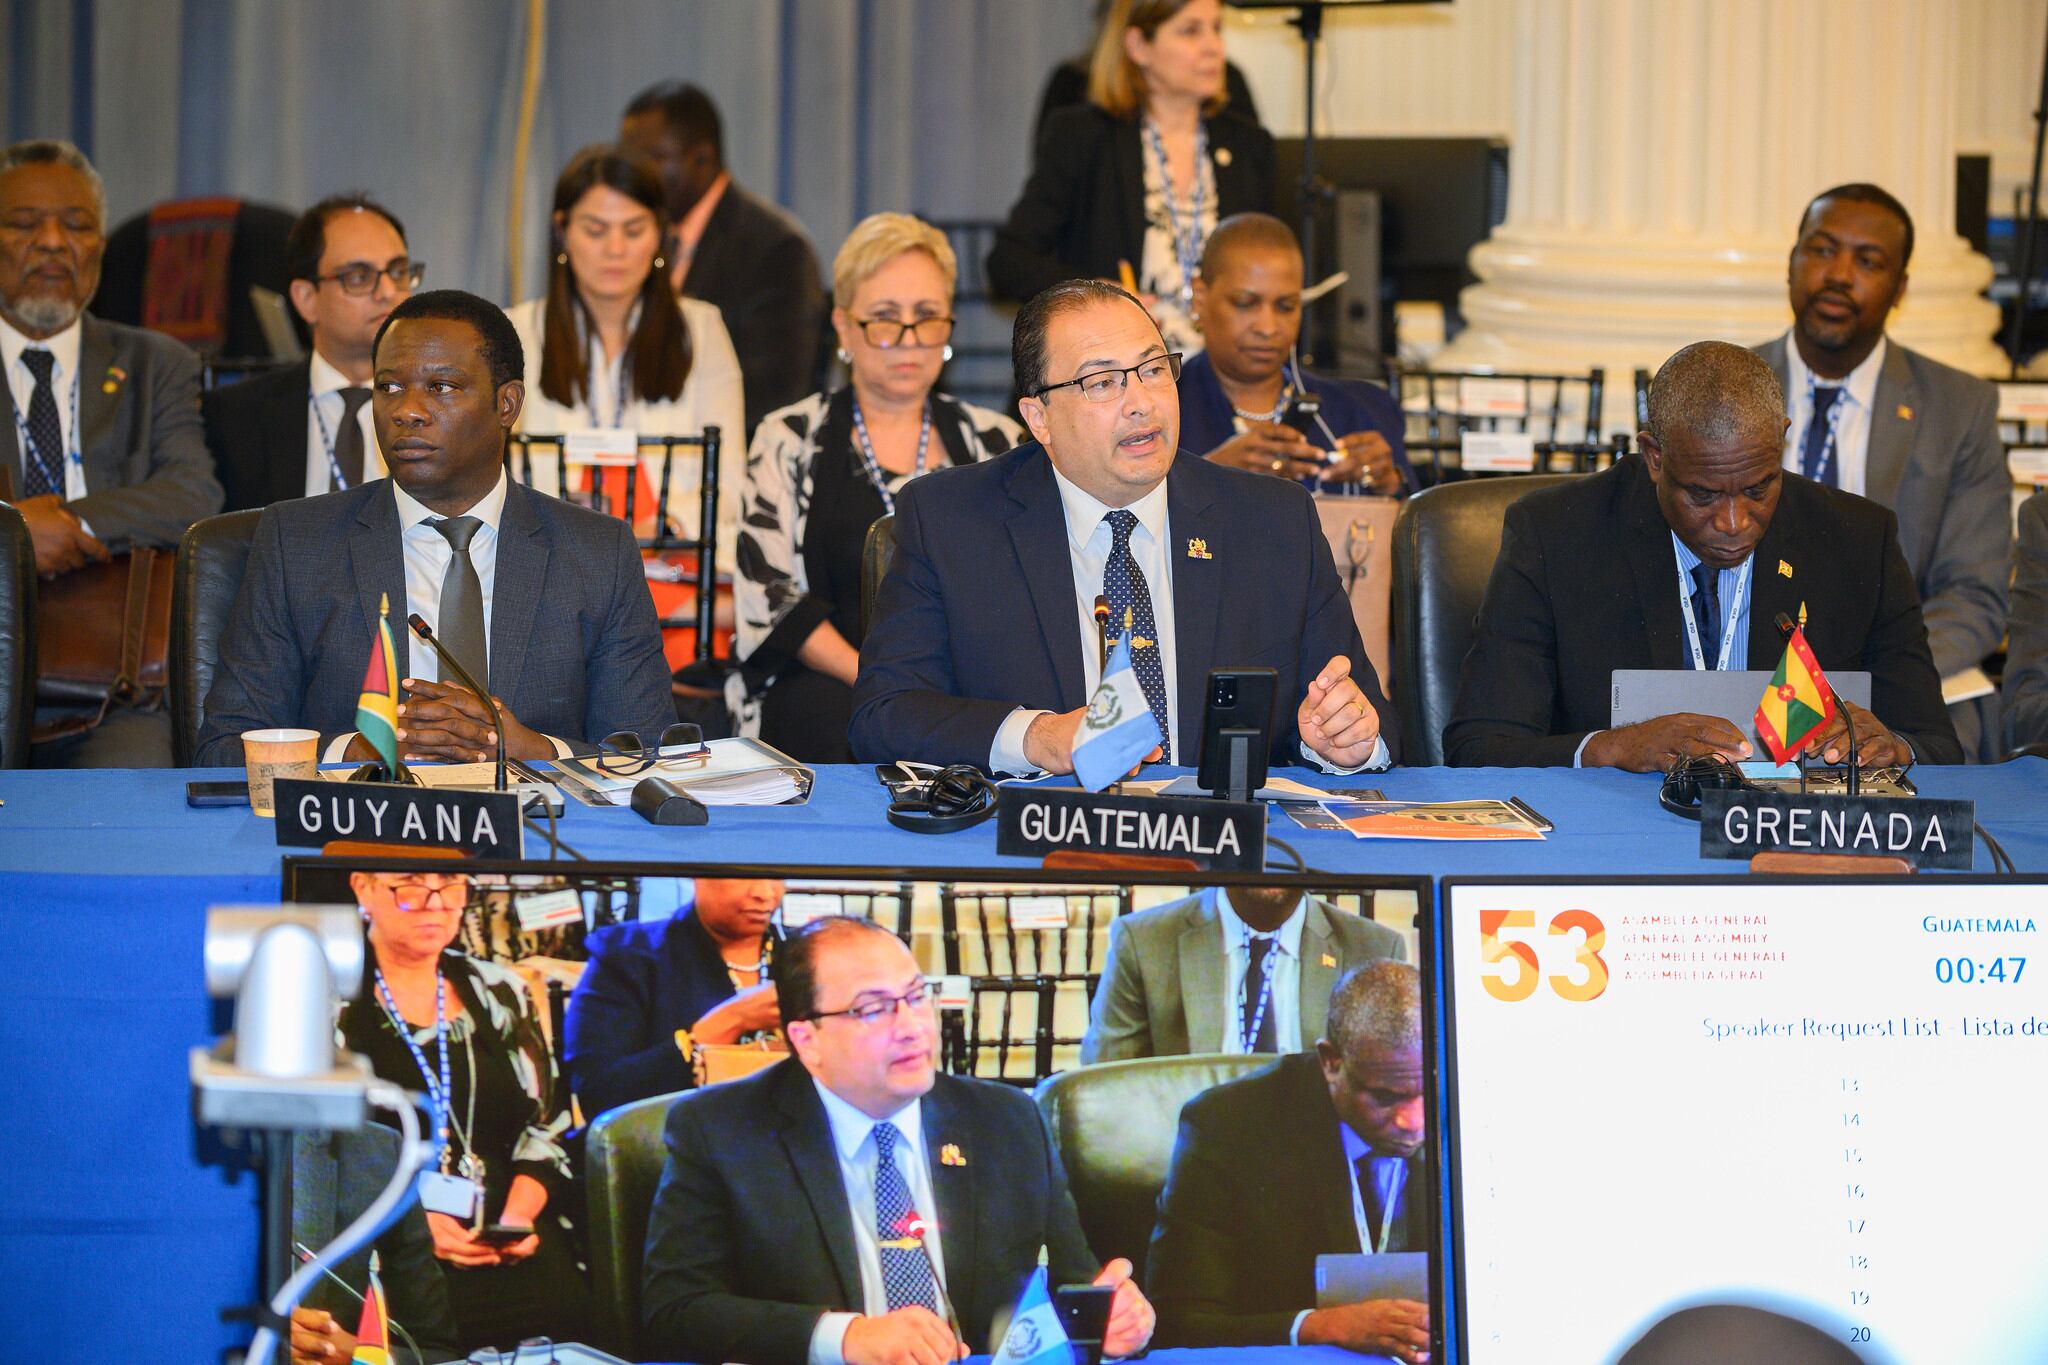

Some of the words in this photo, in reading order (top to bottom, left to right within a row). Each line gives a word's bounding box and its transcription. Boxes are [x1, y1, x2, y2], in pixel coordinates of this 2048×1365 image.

[299, 794, 499, 845] GUYANA
[1020, 803, 1241, 856] GUATEMALA
[1724, 805, 1948, 853] GRENADA
[1704, 915, 1768, 925] GENERAL
[1622, 934, 1686, 943] GENERAL
[1694, 934, 1768, 943] ASSEMBLY
[1479, 909, 1609, 1002] 53
[1720, 971, 1764, 980] GERAL
[1935, 957, 2027, 984] 00:47
[1703, 1018, 1794, 1041] Speaker
[1802, 1017, 1895, 1041] Request
[1903, 1016, 1942, 1037] List
[1963, 1016, 2014, 1036] Lista
[2021, 1016, 2048, 1036] de
[1843, 1113, 1861, 1127] 14
[1848, 1219, 1866, 1233] 17
[1851, 1290, 1870, 1305] 19
[1850, 1326, 1871, 1343] 20
